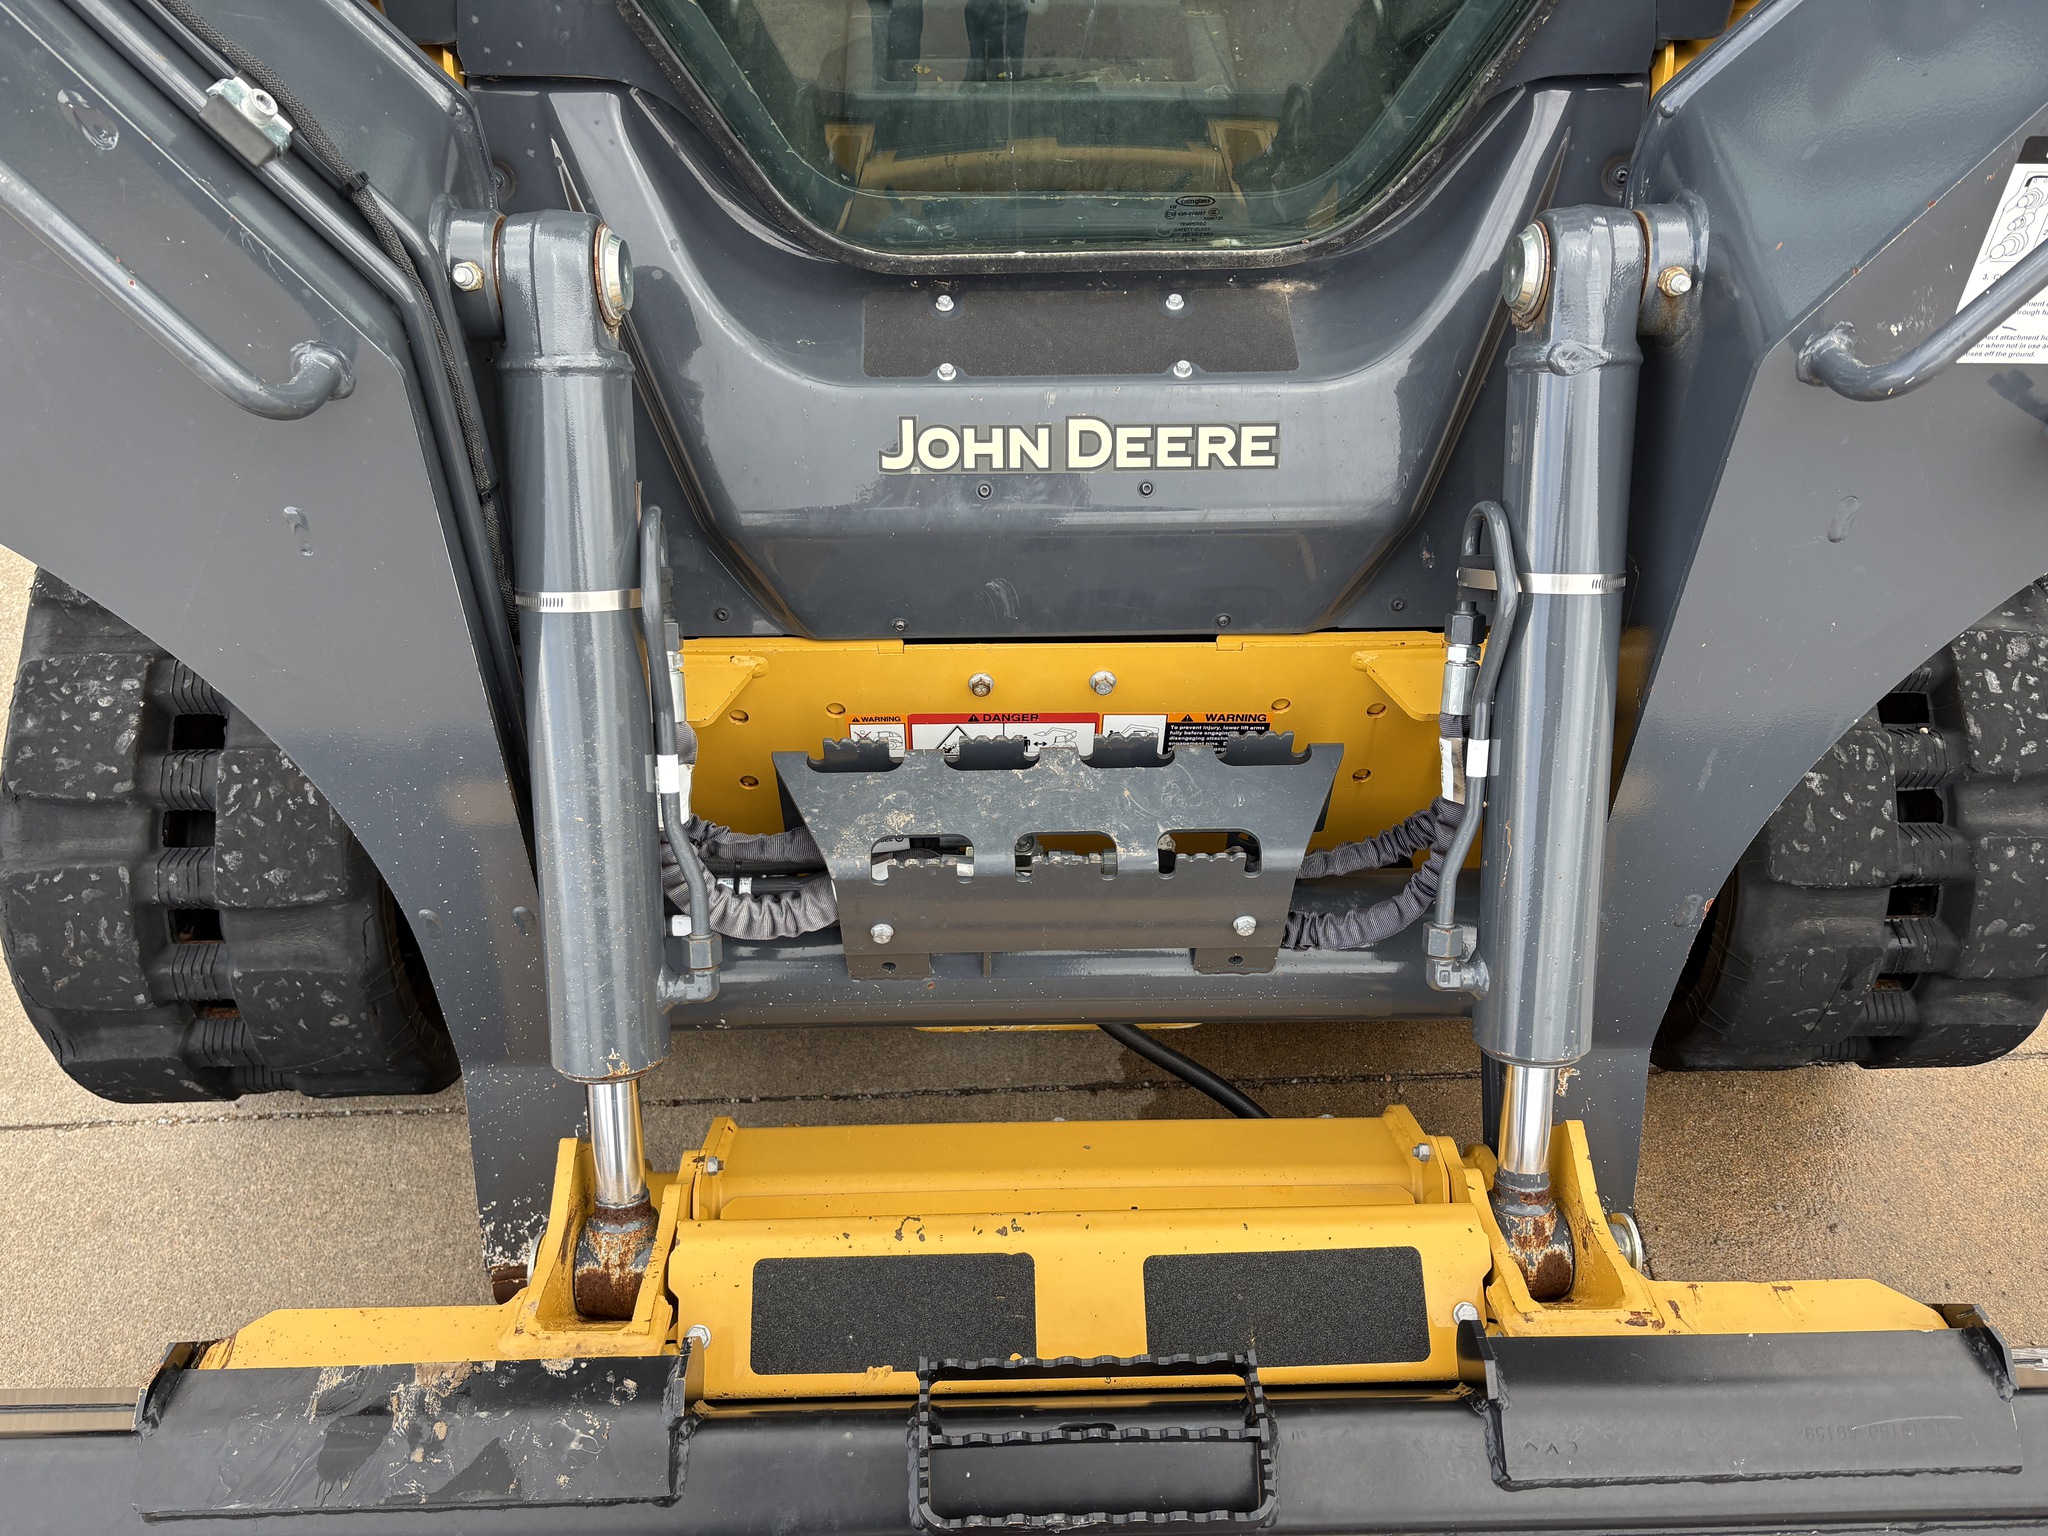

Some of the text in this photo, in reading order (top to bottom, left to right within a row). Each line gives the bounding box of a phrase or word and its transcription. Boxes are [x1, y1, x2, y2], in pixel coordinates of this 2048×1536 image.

[1982, 273, 1989, 281] 3.
[2007, 350, 2036, 359] ground.
[879, 415, 1280, 472] JOHN DEERE
[982, 713, 1040, 723] DANGER
[1205, 713, 1268, 723] WARNING
